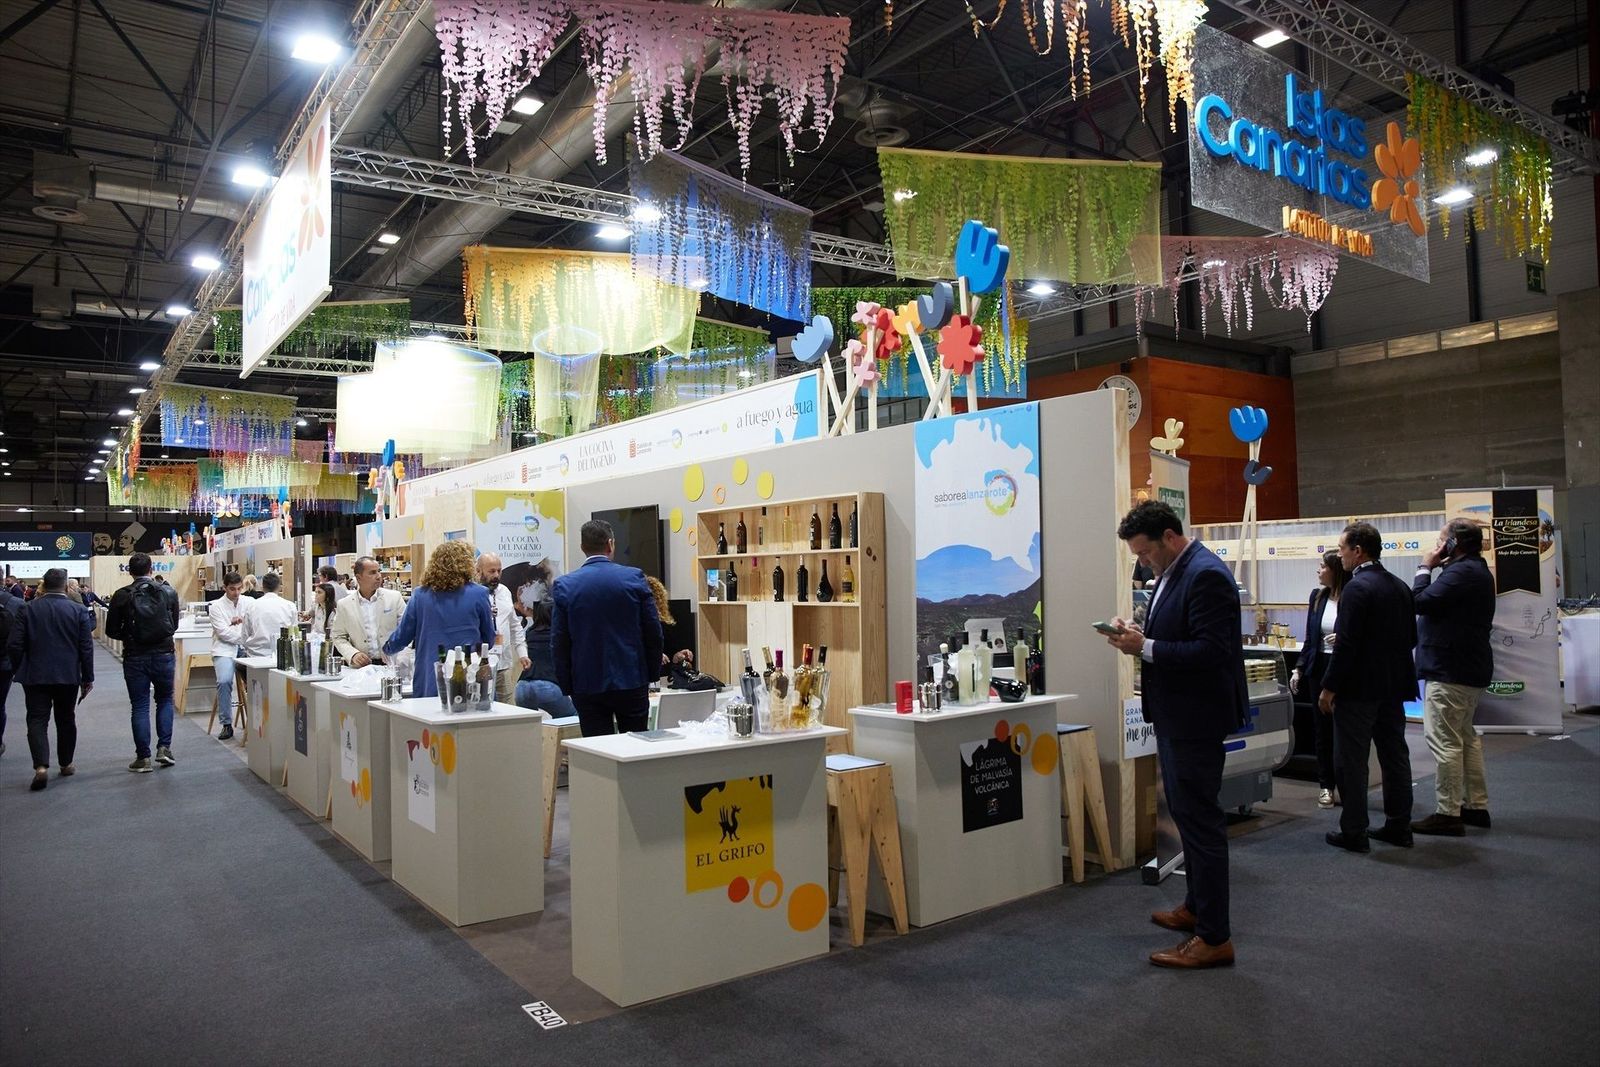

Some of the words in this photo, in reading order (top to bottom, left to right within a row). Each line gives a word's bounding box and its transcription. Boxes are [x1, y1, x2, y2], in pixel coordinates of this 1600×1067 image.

[1285, 73, 1368, 160] Islas
[1195, 93, 1370, 210] Canarias
[247, 228, 296, 325] Canas
[736, 416, 743, 428] a
[744, 409, 775, 427] fuego
[774, 406, 782, 423] y
[785, 399, 813, 421] agua
[1494, 519, 1504, 527] La
[1504, 518, 1538, 527] Irlandesa
[498, 543, 512, 551] DEL
[513, 543, 542, 551] INGENIO
[1380, 541, 1419, 550] oexca
[118, 561, 168, 572] teife
[1125, 716, 1143, 725] CANA
[975, 756, 1007, 771] LÁGRIMA
[969, 774, 980, 784] DE
[981, 767, 1013, 781] MALVASÍA
[974, 780, 1010, 794] VOLCÁNICA
[695, 852, 715, 868] EL
[718, 842, 766, 863] GRIFO
[525, 1002, 563, 1027] 7B40
